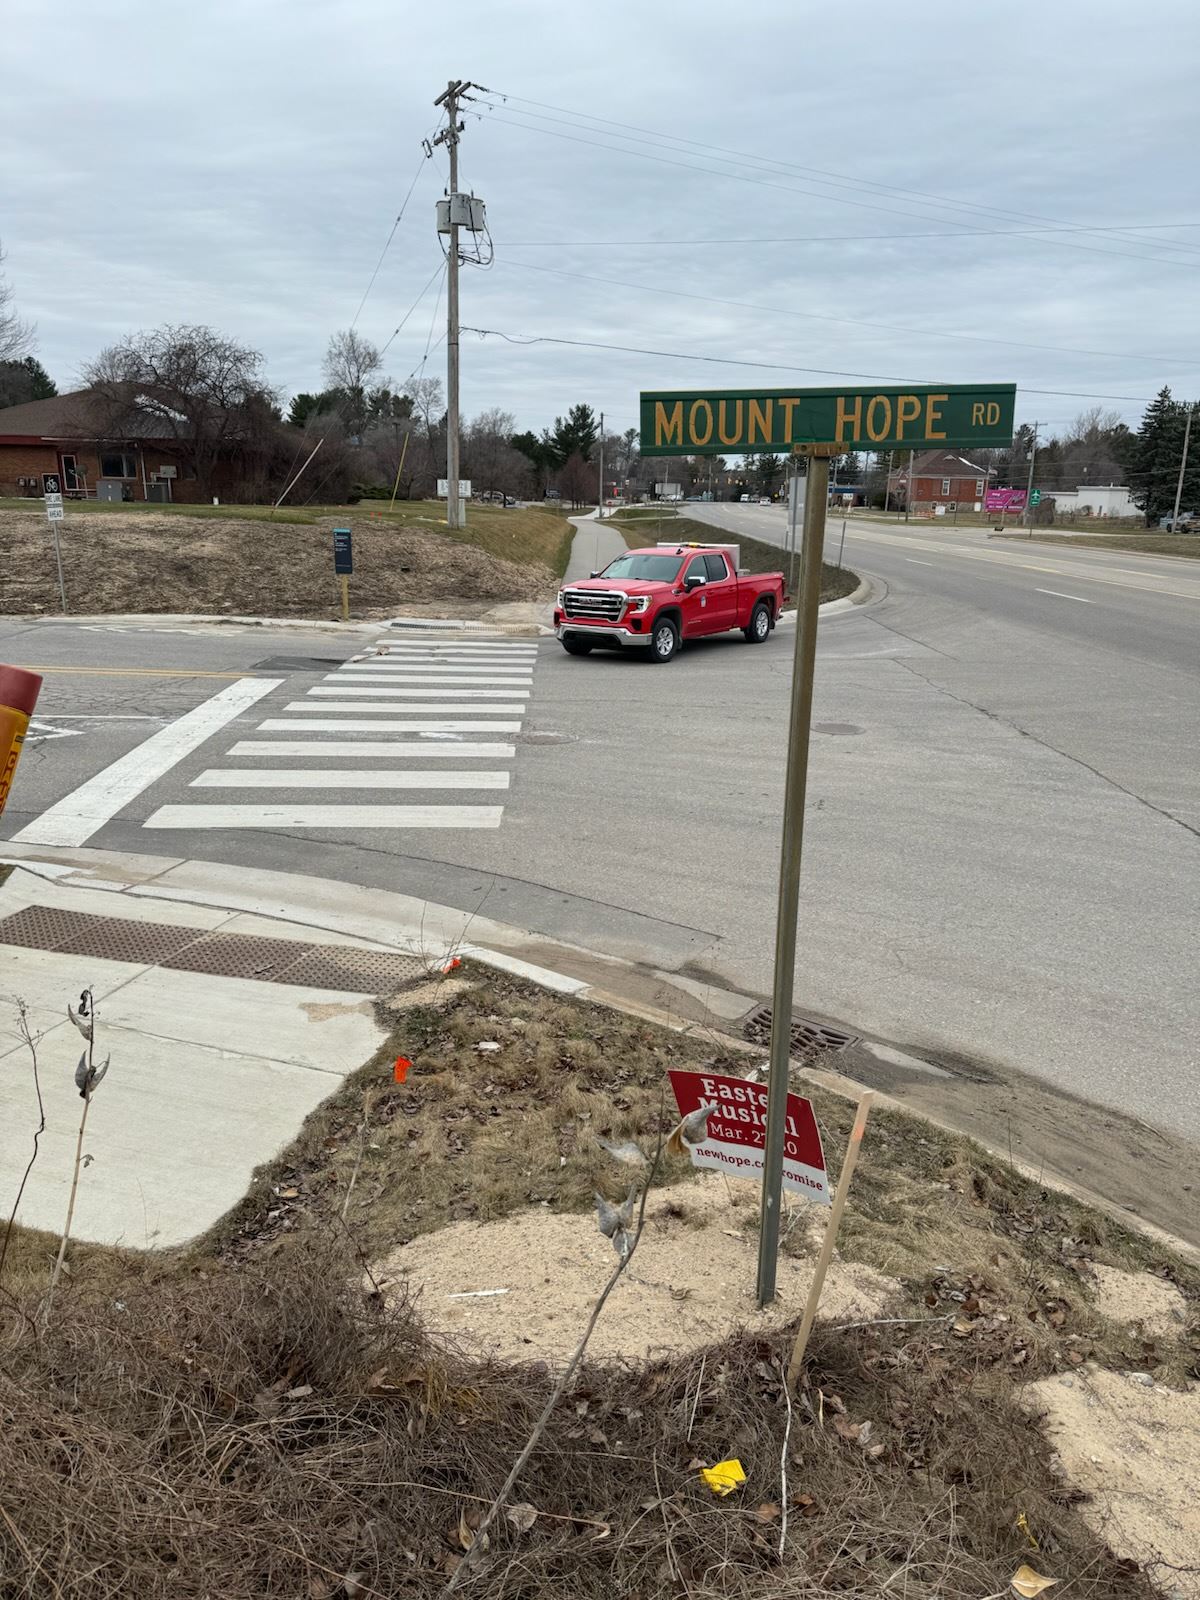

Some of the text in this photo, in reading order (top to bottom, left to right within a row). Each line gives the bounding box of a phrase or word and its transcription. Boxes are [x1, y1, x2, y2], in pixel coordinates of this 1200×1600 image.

[654, 394, 1001, 447] MOUNT HOPE RD
[700, 1078, 768, 1108] Easte
[710, 1122, 748, 1141] Mar.
